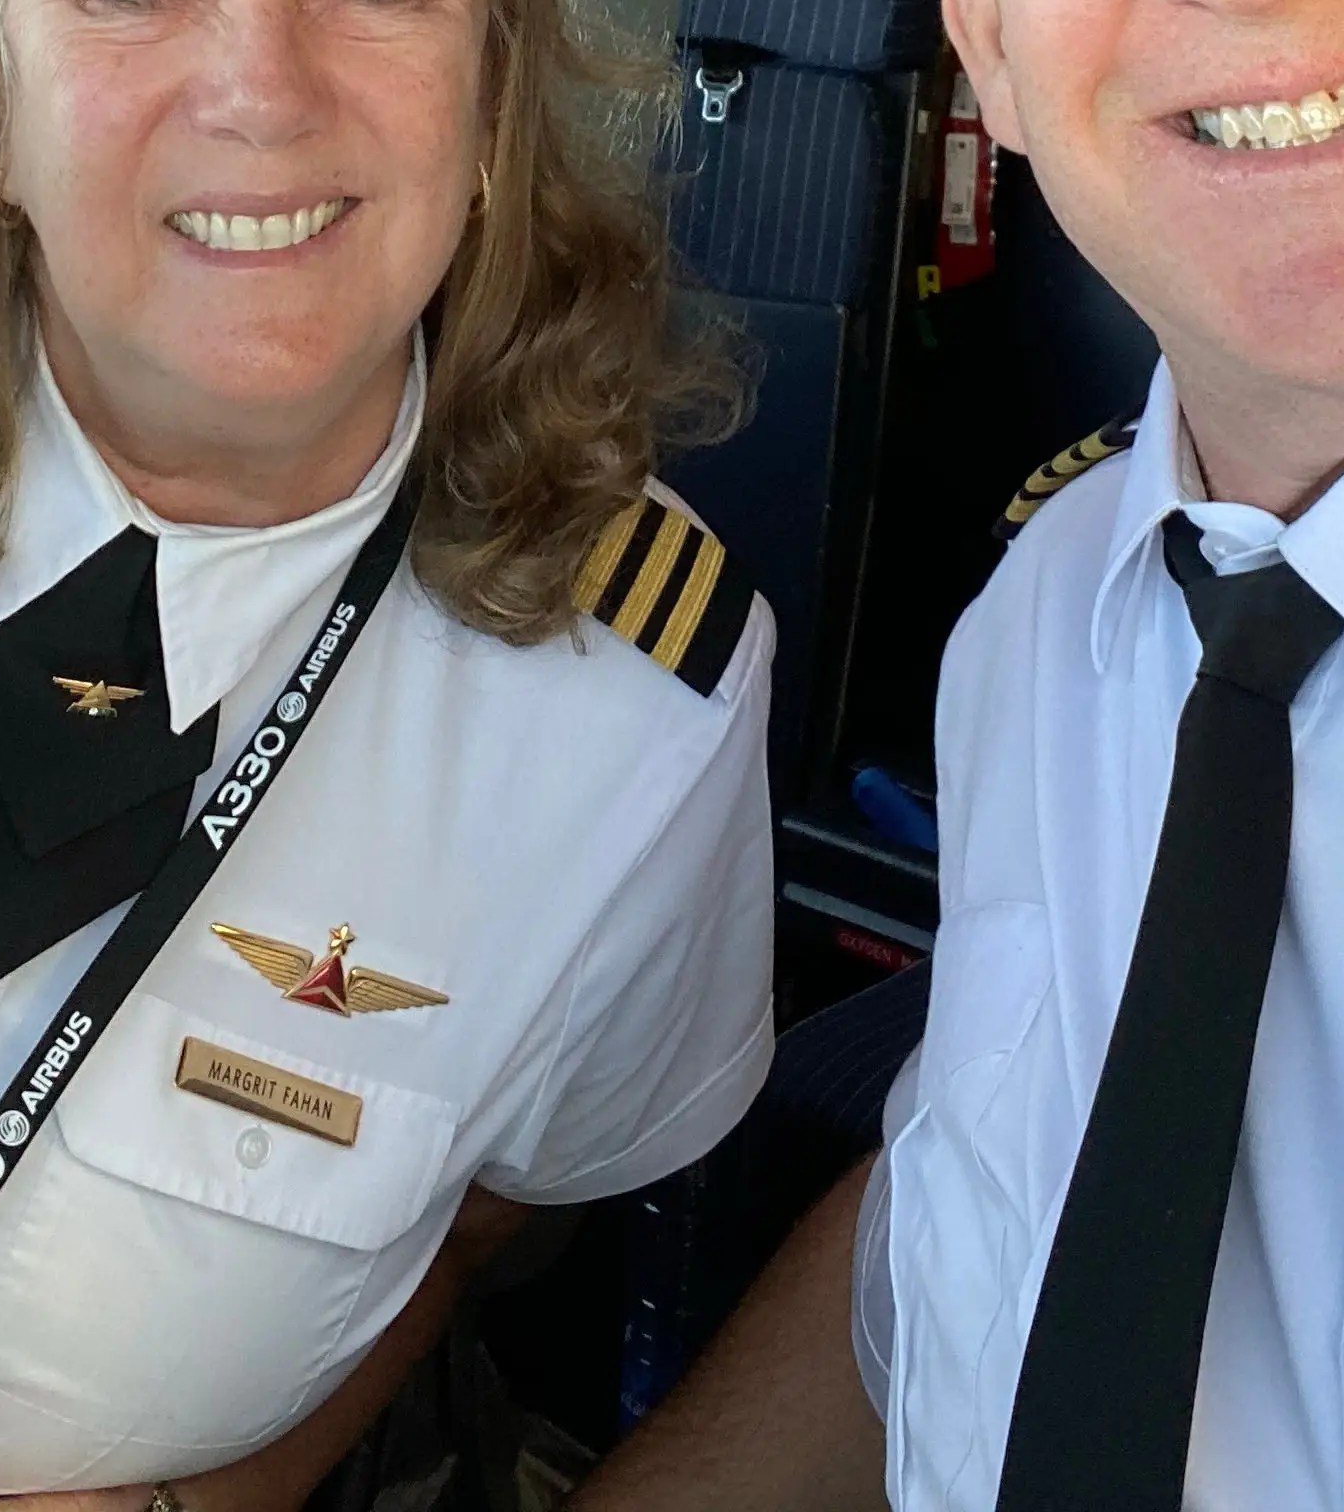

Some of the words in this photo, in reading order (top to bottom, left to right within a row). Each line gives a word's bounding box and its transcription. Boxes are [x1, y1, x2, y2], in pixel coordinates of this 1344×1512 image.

[202, 726, 286, 851] A330
[298, 602, 356, 693] AIRBUS
[21, 1010, 93, 1116] AIRBUS
[208, 1059, 277, 1100] MARGRIT
[282, 1086, 334, 1121] FAHAN
